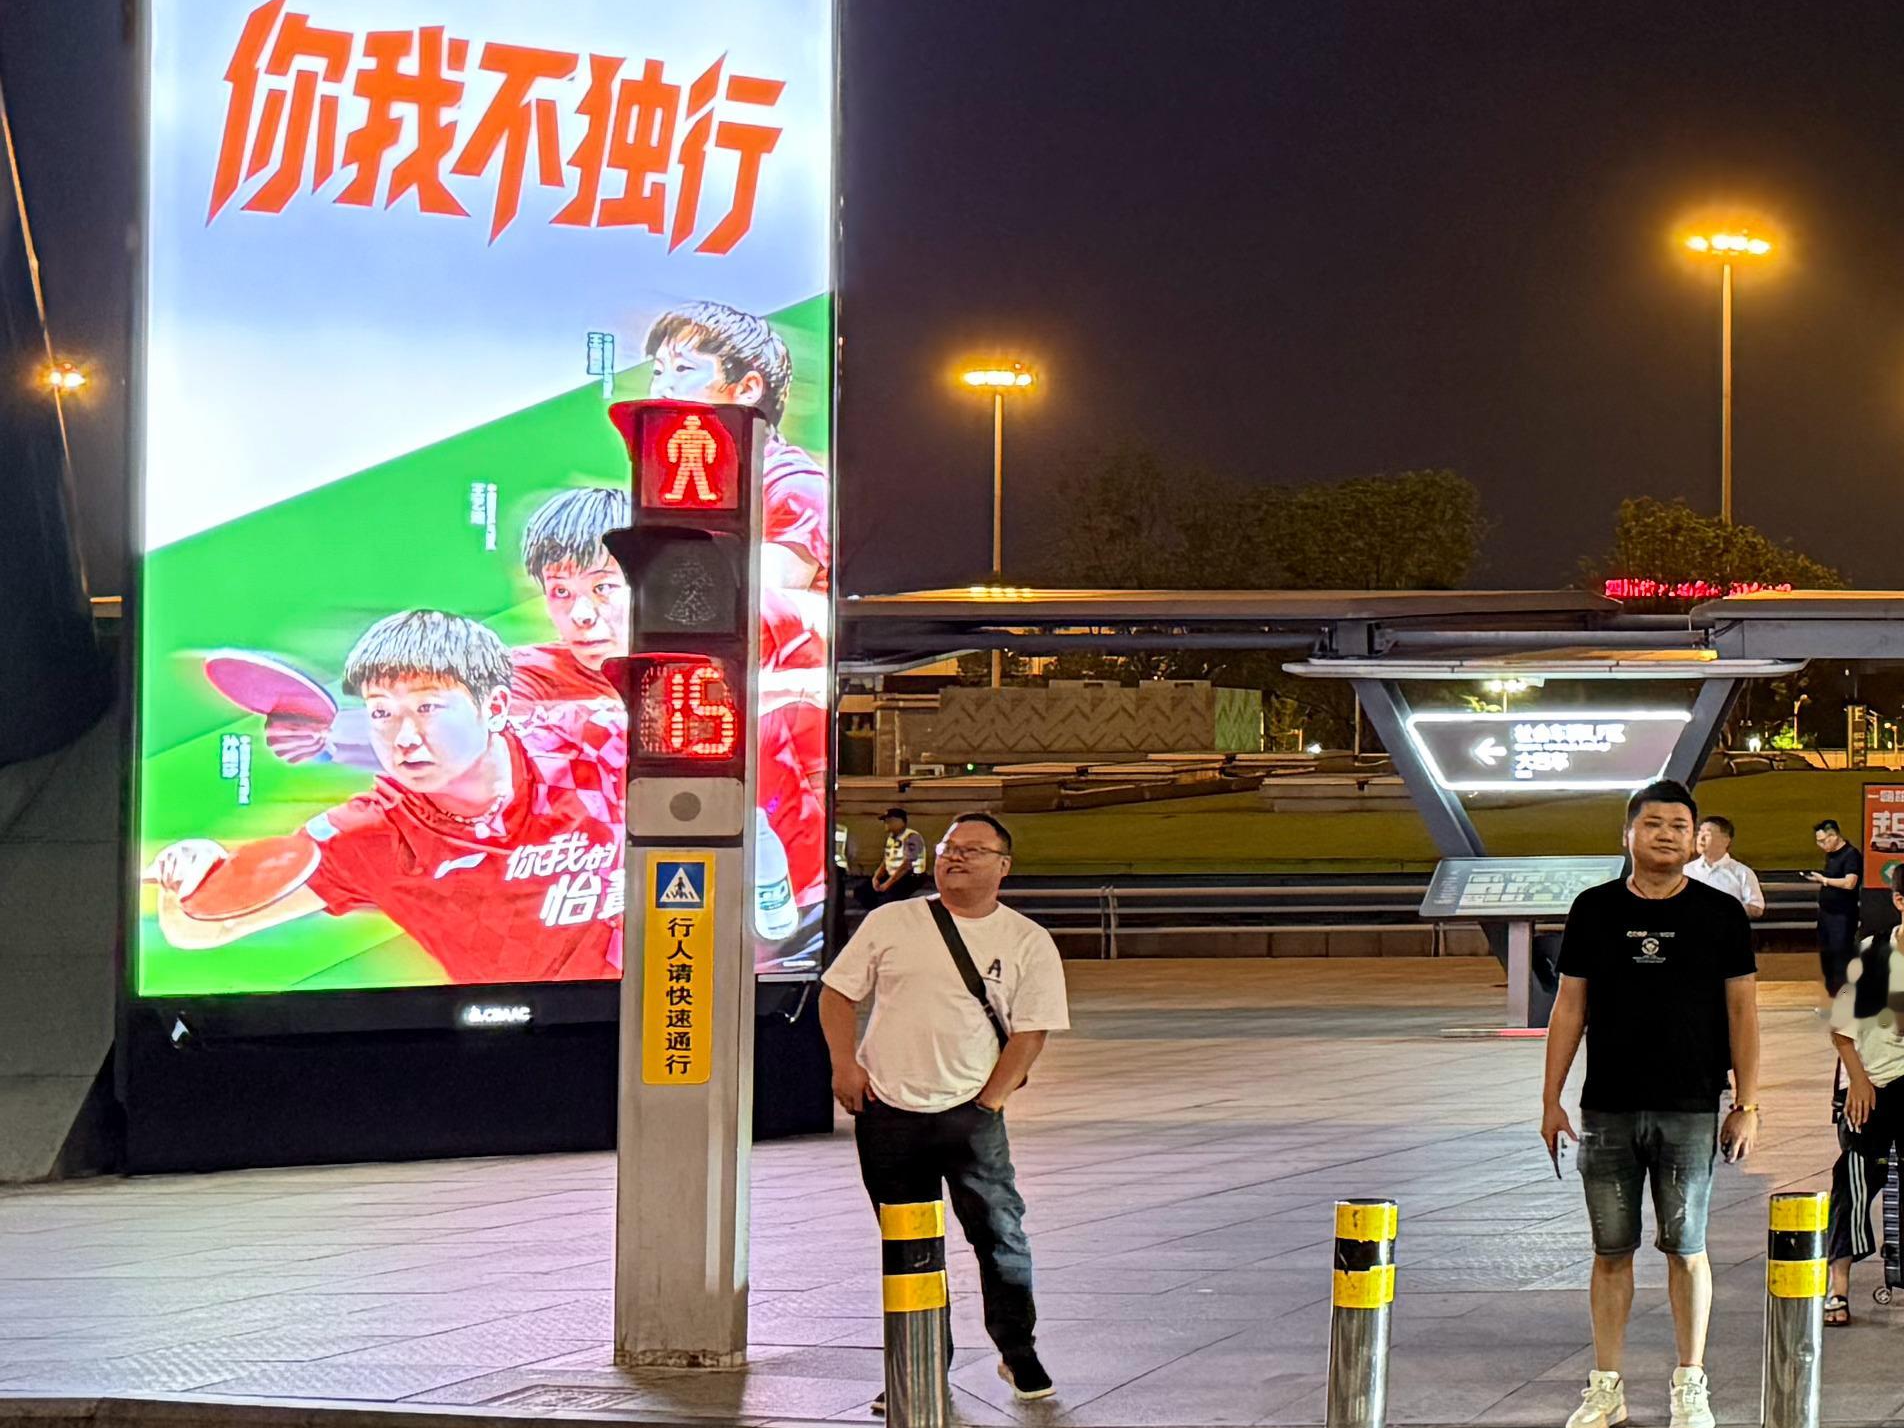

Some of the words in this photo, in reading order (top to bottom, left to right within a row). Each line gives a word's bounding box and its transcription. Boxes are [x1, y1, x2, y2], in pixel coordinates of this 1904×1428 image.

[670, 667, 736, 756] 15
[504, 830, 616, 881] 你我的
[665, 917, 695, 1076] 行人请快速通行
